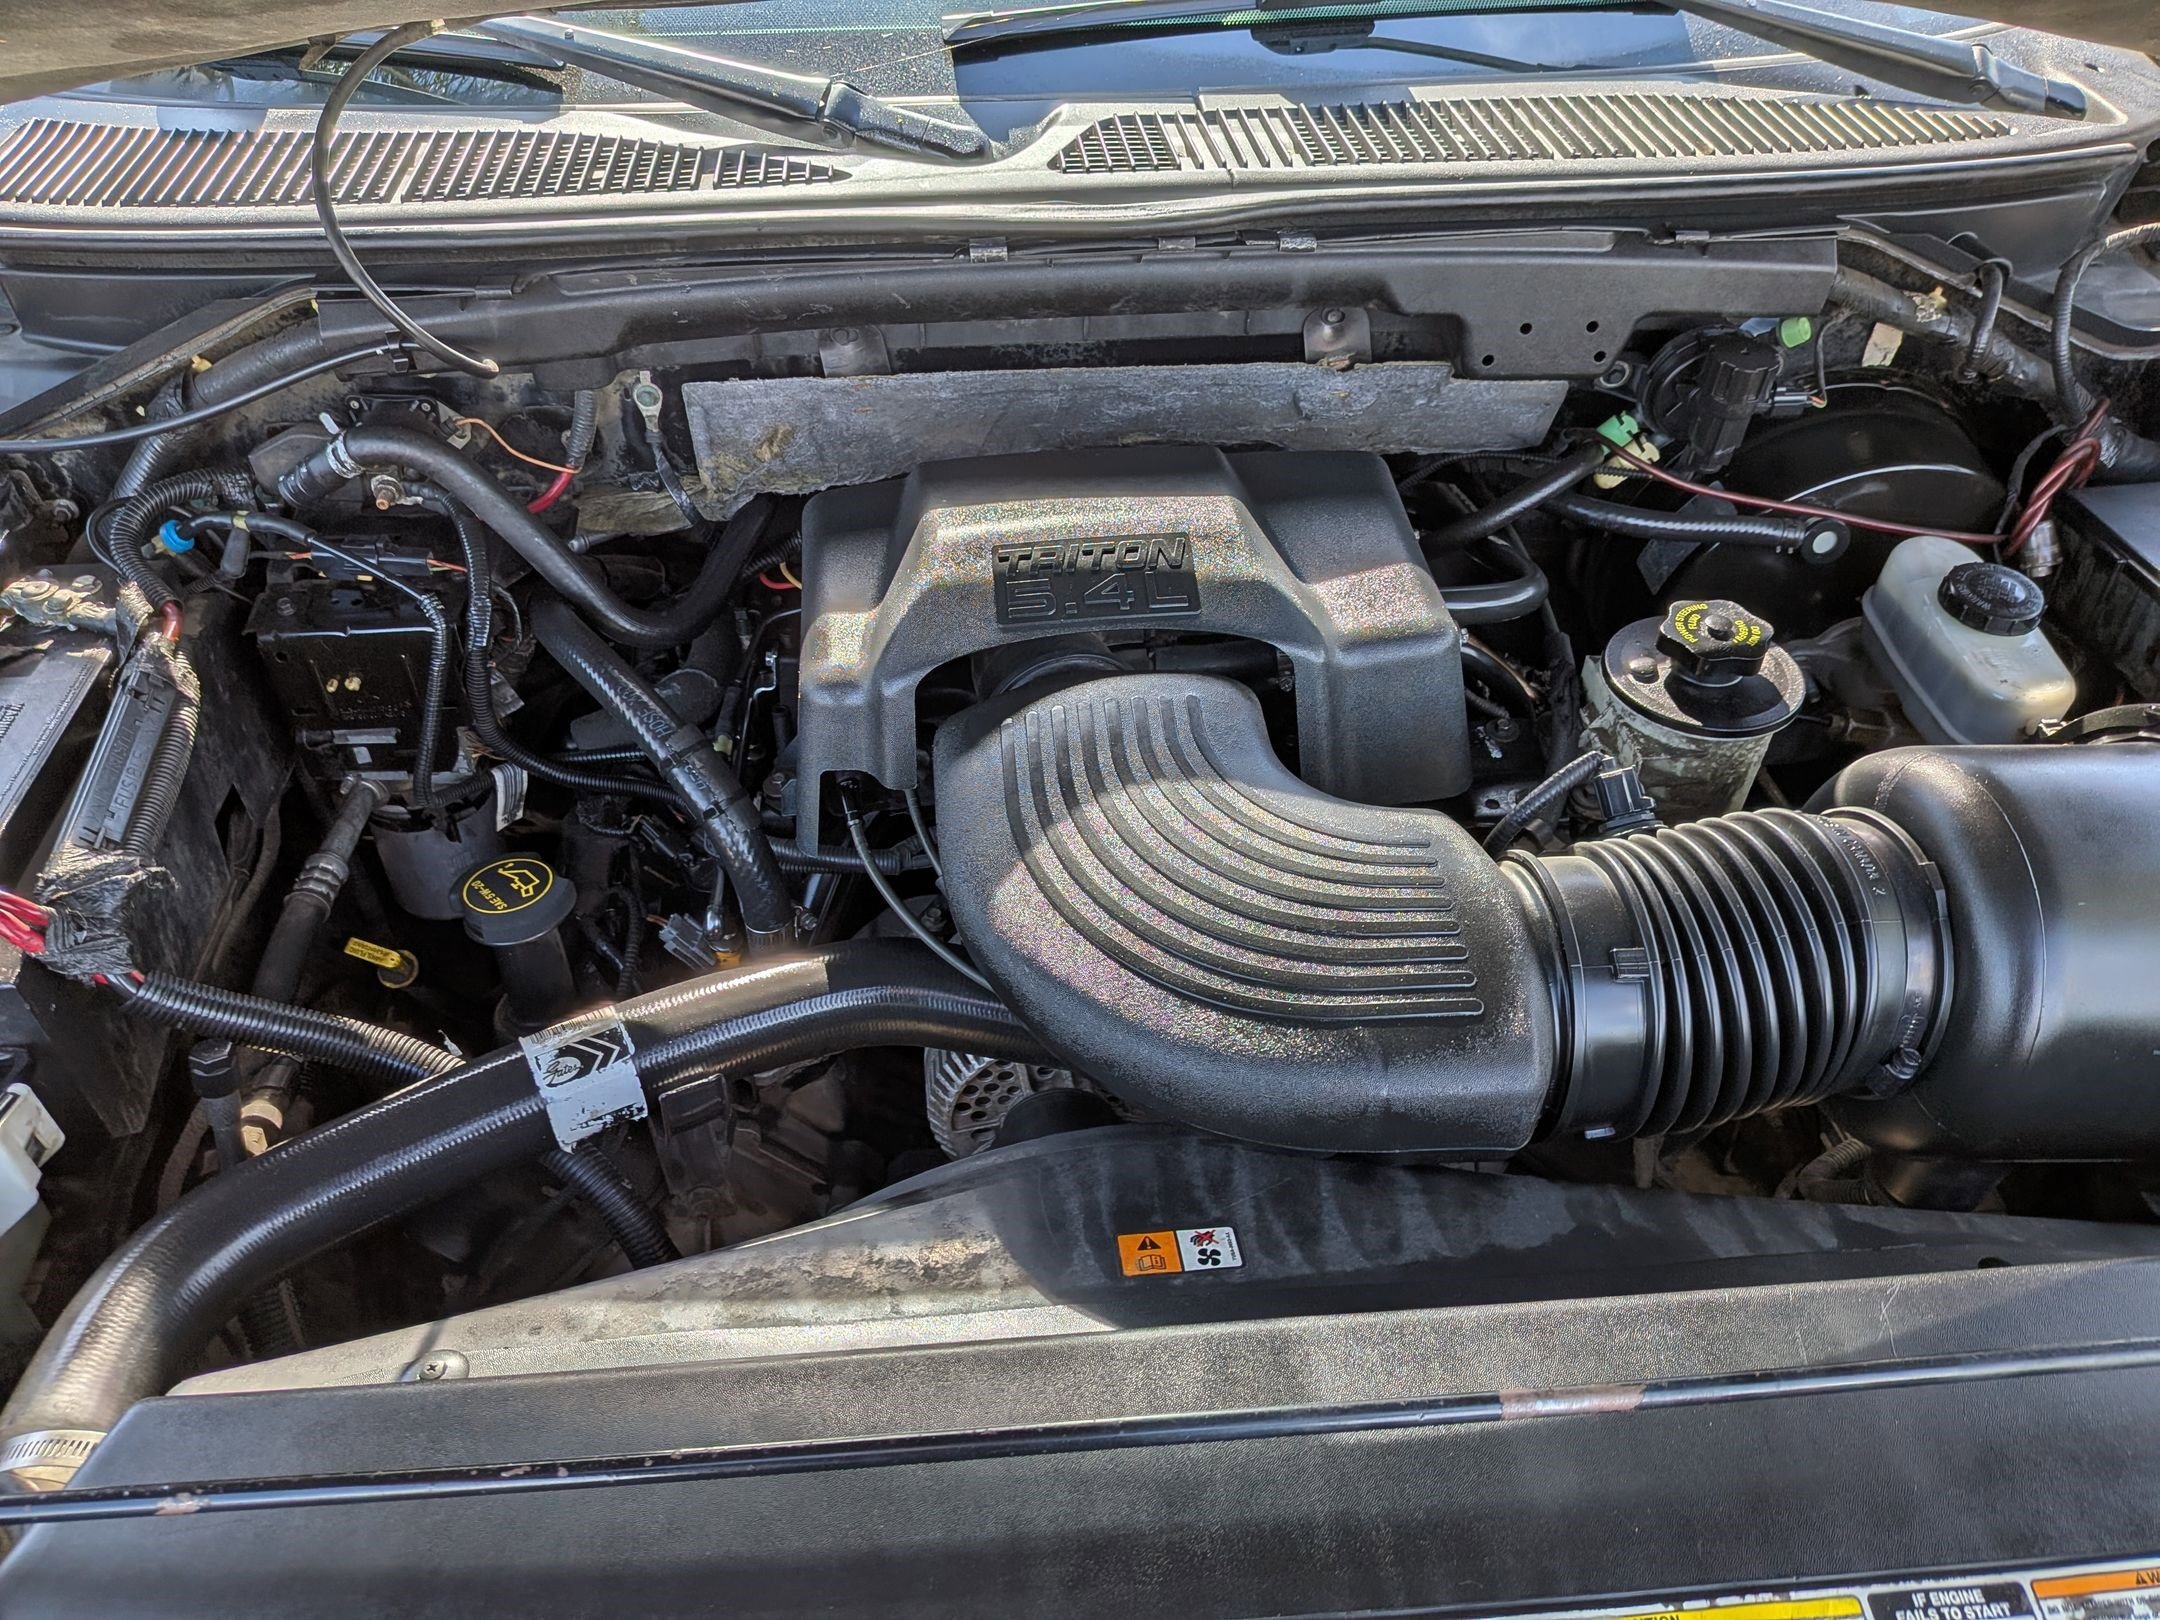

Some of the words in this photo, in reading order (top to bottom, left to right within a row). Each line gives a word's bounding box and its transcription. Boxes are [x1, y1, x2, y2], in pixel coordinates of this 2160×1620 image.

[998, 537, 1186, 577] TRITON
[1006, 571, 1189, 619] 5.4L
[1675, 603, 1709, 622] STEERING
[1687, 613, 1701, 630] FLUID
[1674, 621, 1698, 644] POWER
[1750, 625, 1761, 635] DO
[1746, 634, 1761, 647] NOT
[471, 880, 495, 900] 5W-20
[490, 896, 508, 910] SAE
[543, 1060, 584, 1086] Gates
[1911, 1592, 1927, 1608] IF
[1928, 1588, 1986, 1607] ENGINE
[1940, 1605, 1962, 1620] TO
[1964, 1602, 2011, 1620] START
